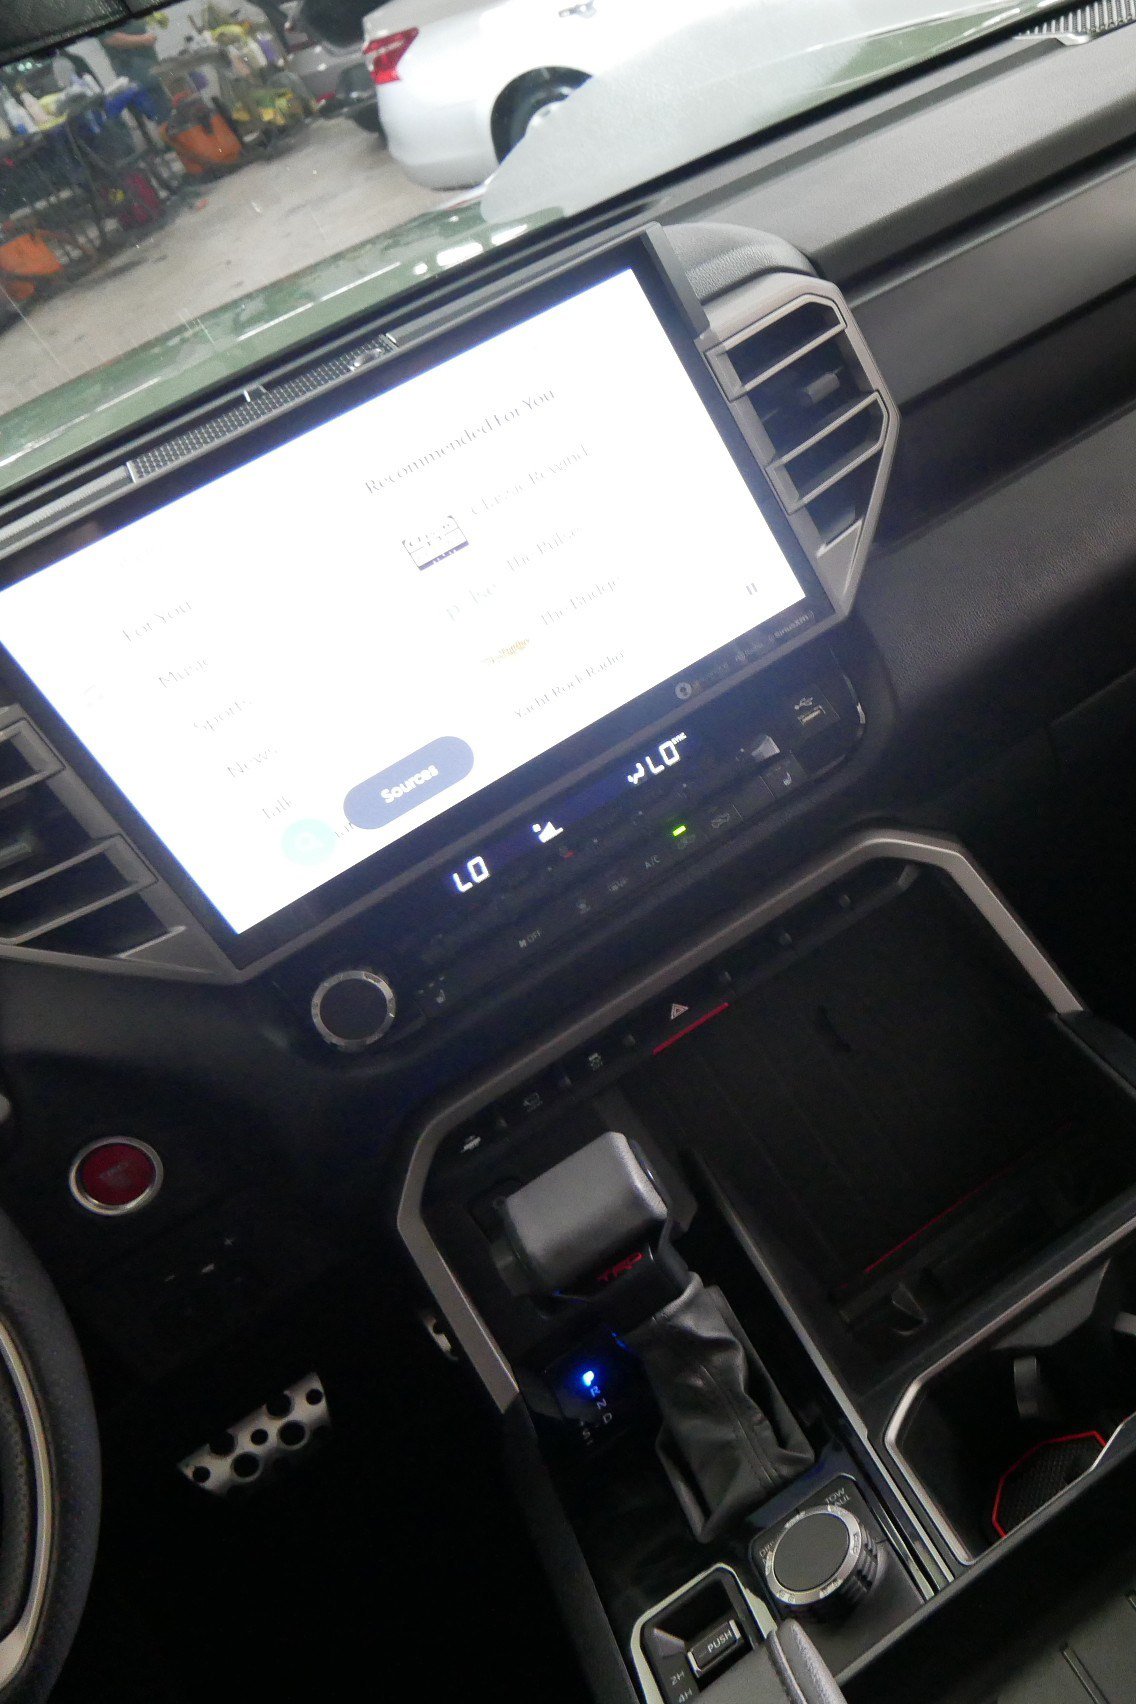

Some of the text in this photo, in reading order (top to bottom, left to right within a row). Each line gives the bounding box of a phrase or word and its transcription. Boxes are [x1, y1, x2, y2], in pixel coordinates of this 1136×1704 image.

[364, 389, 556, 494] Recommended For You
[645, 740, 680, 775] LO
[380, 764, 440, 804] Sources
[451, 855, 491, 893] LO
[707, 1629, 733, 1653] PUSH
[670, 1671, 685, 1686] 2H
[678, 1687, 693, 1703] 4H
